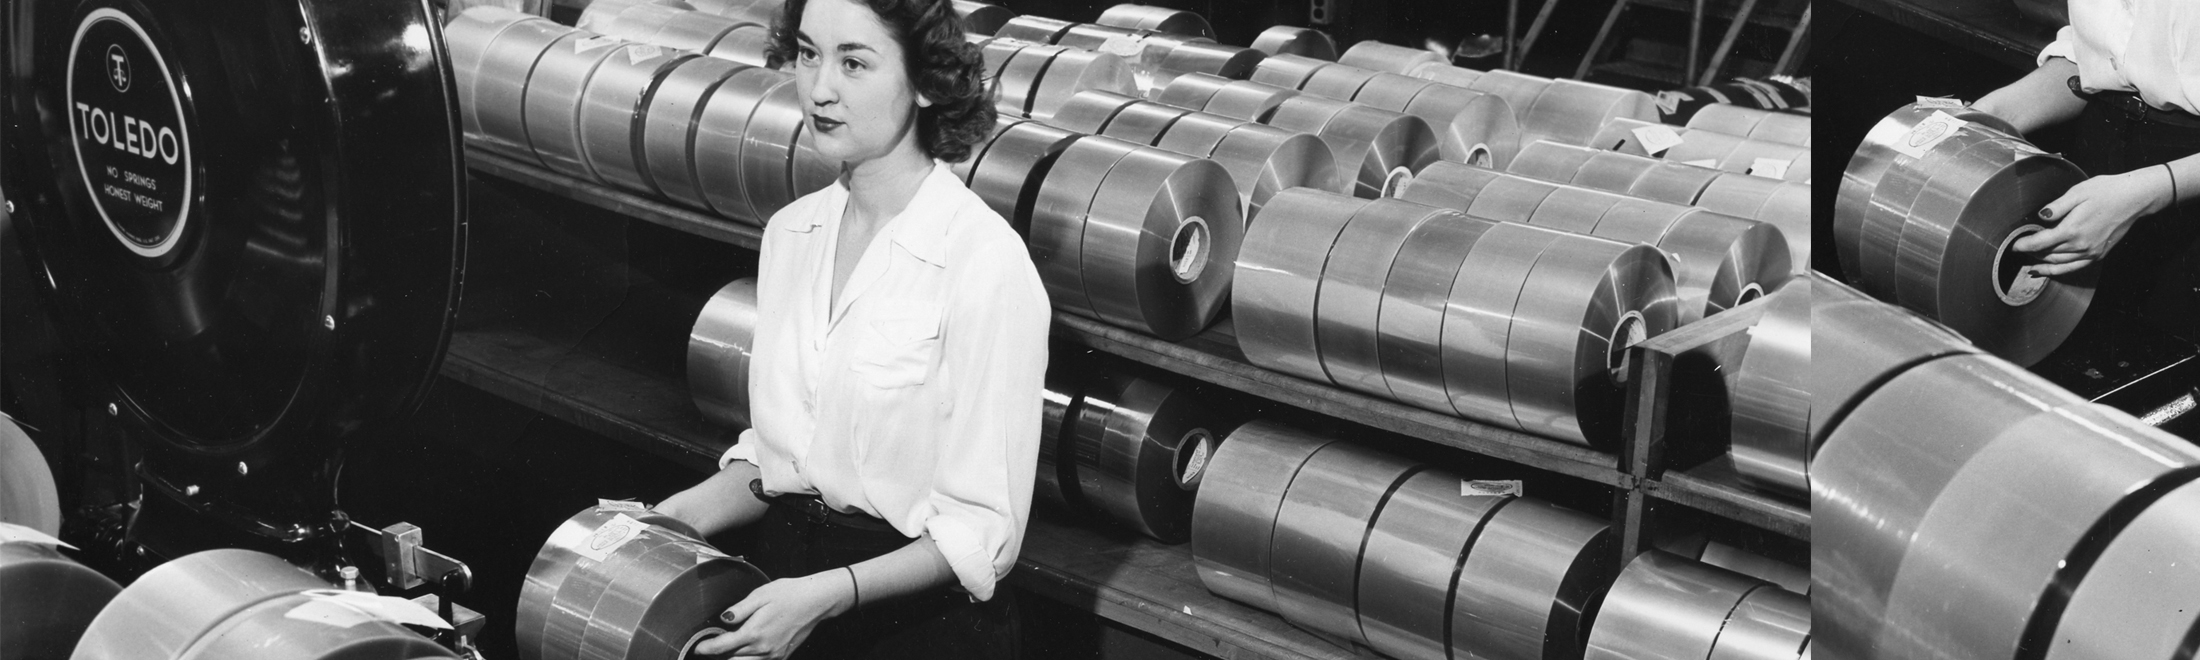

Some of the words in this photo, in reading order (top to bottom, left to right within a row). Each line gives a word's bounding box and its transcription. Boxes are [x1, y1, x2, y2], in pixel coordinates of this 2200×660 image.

[76, 101, 179, 165] TOLEDO
[106, 165, 118, 179] NO
[124, 170, 156, 191] SPRINGS
[104, 184, 131, 202] HONEST
[135, 194, 163, 212] WEIGHT
